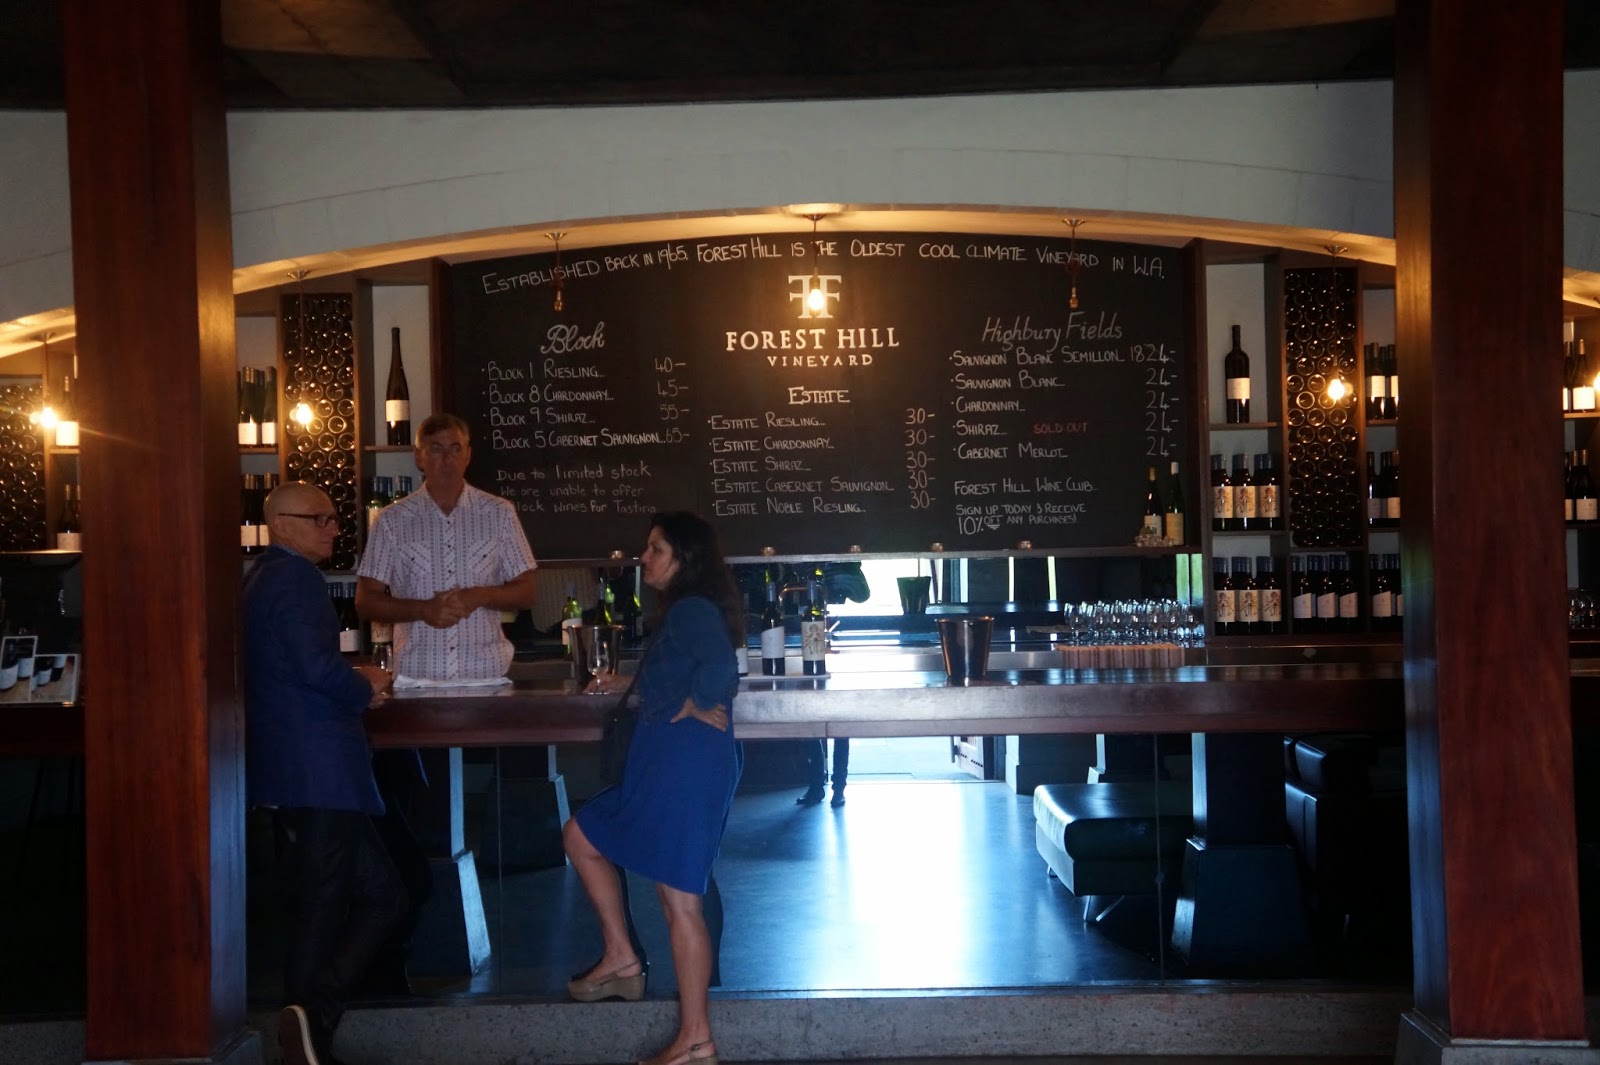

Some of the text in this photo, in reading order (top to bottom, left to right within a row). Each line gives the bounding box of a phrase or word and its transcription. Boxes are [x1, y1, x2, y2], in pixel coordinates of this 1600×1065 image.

[482, 260, 600, 294] ESTABLISHED
[604, 254, 639, 272] BACK
[643, 253, 654, 266] IN
[697, 243, 748, 262] FOREST
[750, 237, 782, 258] HILL
[790, 242, 805, 257] IS
[810, 240, 839, 256] THE
[850, 239, 905, 257] OLDEST
[919, 243, 960, 259] COOL
[965, 244, 1027, 261] CLIMATE
[1036, 246, 1099, 267] VINEYARD
[1112, 256, 1125, 271] IN
[540, 321, 604, 354] Block
[726, 327, 900, 351] FOREST HILL
[982, 311, 1123, 353] Highbury Fields
[767, 354, 873, 367] VINEYARD
[952, 350, 1007, 366] SAUVIGNON
[1016, 347, 1054, 365] BLANC
[488, 361, 524, 381] BLOCK
[955, 373, 1011, 389] SAUVIGNON
[489, 383, 525, 404] BLOCK
[529, 384, 540, 403] 8
[788, 386, 850, 405] ESTATE
[490, 407, 525, 426] BLOCK
[530, 407, 540, 423] 9
[711, 415, 759, 430] ESTATE
[1034, 422, 1065, 434] SOLD
[1067, 422, 1088, 433] OUT
[492, 430, 530, 449] BLOCK
[535, 431, 545, 448] 5
[549, 431, 598, 447] CABERNET
[712, 437, 760, 453] ESTATE
[957, 443, 1008, 459] CABERNET
[496, 460, 651, 481] Due to limited stock
[713, 458, 758, 474] ESTATE
[501, 484, 644, 497] We are unable to offer
[714, 478, 761, 493] ESTATE
[765, 477, 823, 492] CABERNET
[954, 480, 997, 495] FOREST
[1003, 477, 1031, 493] HILL
[1036, 477, 1063, 492] WINE
[516, 499, 544, 512] lock
[715, 500, 759, 516] ESTATE
[766, 497, 804, 514] NOBLE
[955, 504, 981, 516] SIGN
[985, 505, 999, 515] UP
[1002, 504, 1032, 515] TODAY
[1044, 503, 1087, 514] RECEIVE
[1006, 515, 1023, 525] ANY
